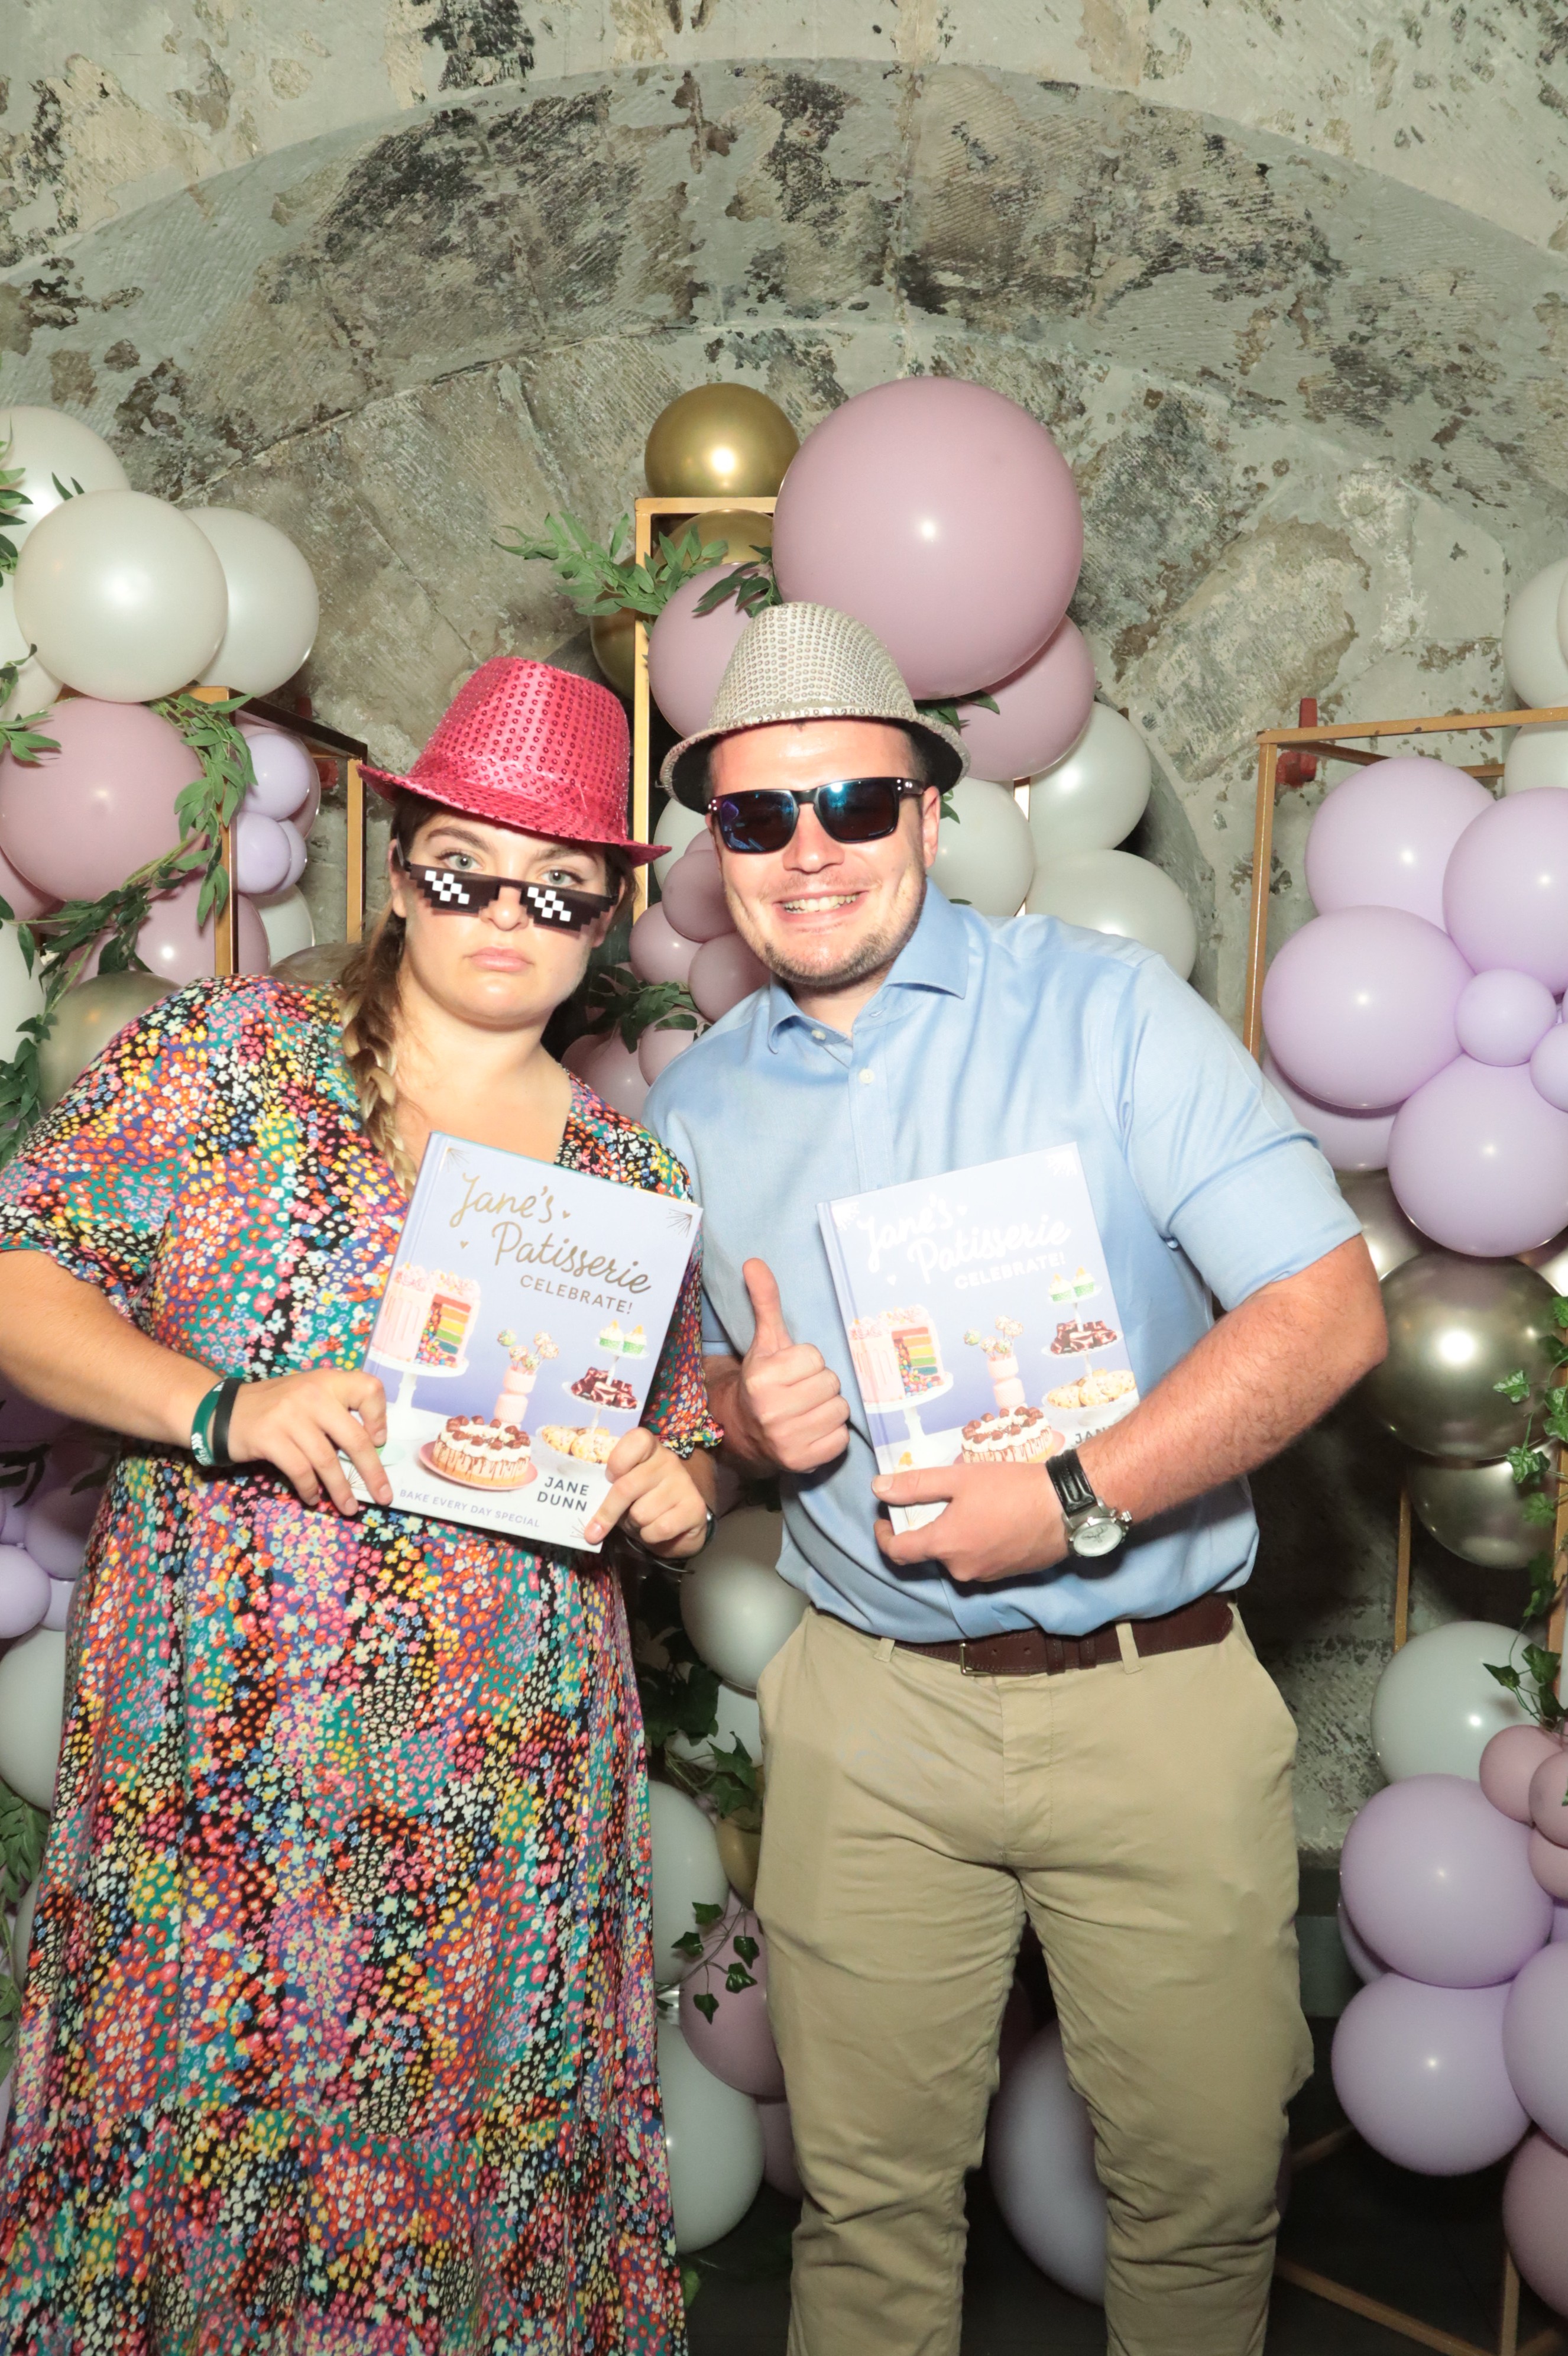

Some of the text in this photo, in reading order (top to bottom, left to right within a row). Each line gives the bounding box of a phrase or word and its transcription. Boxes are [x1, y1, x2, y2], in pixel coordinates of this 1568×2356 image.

[449, 1172, 554, 1228] Jane's
[857, 1193, 954, 1273] Jane's
[906, 1213, 1072, 1285] Patisserie
[491, 1221, 652, 1294] Patisserie
[954, 1251, 1067, 1290] CELEBRATE!
[520, 1274, 633, 1315] CELEBRATE!
[537, 1491, 588, 1512] DUNN
[544, 1476, 590, 1496] JANE
[399, 1488, 540, 1528] BAKE EVERY DAY SPECIAL
